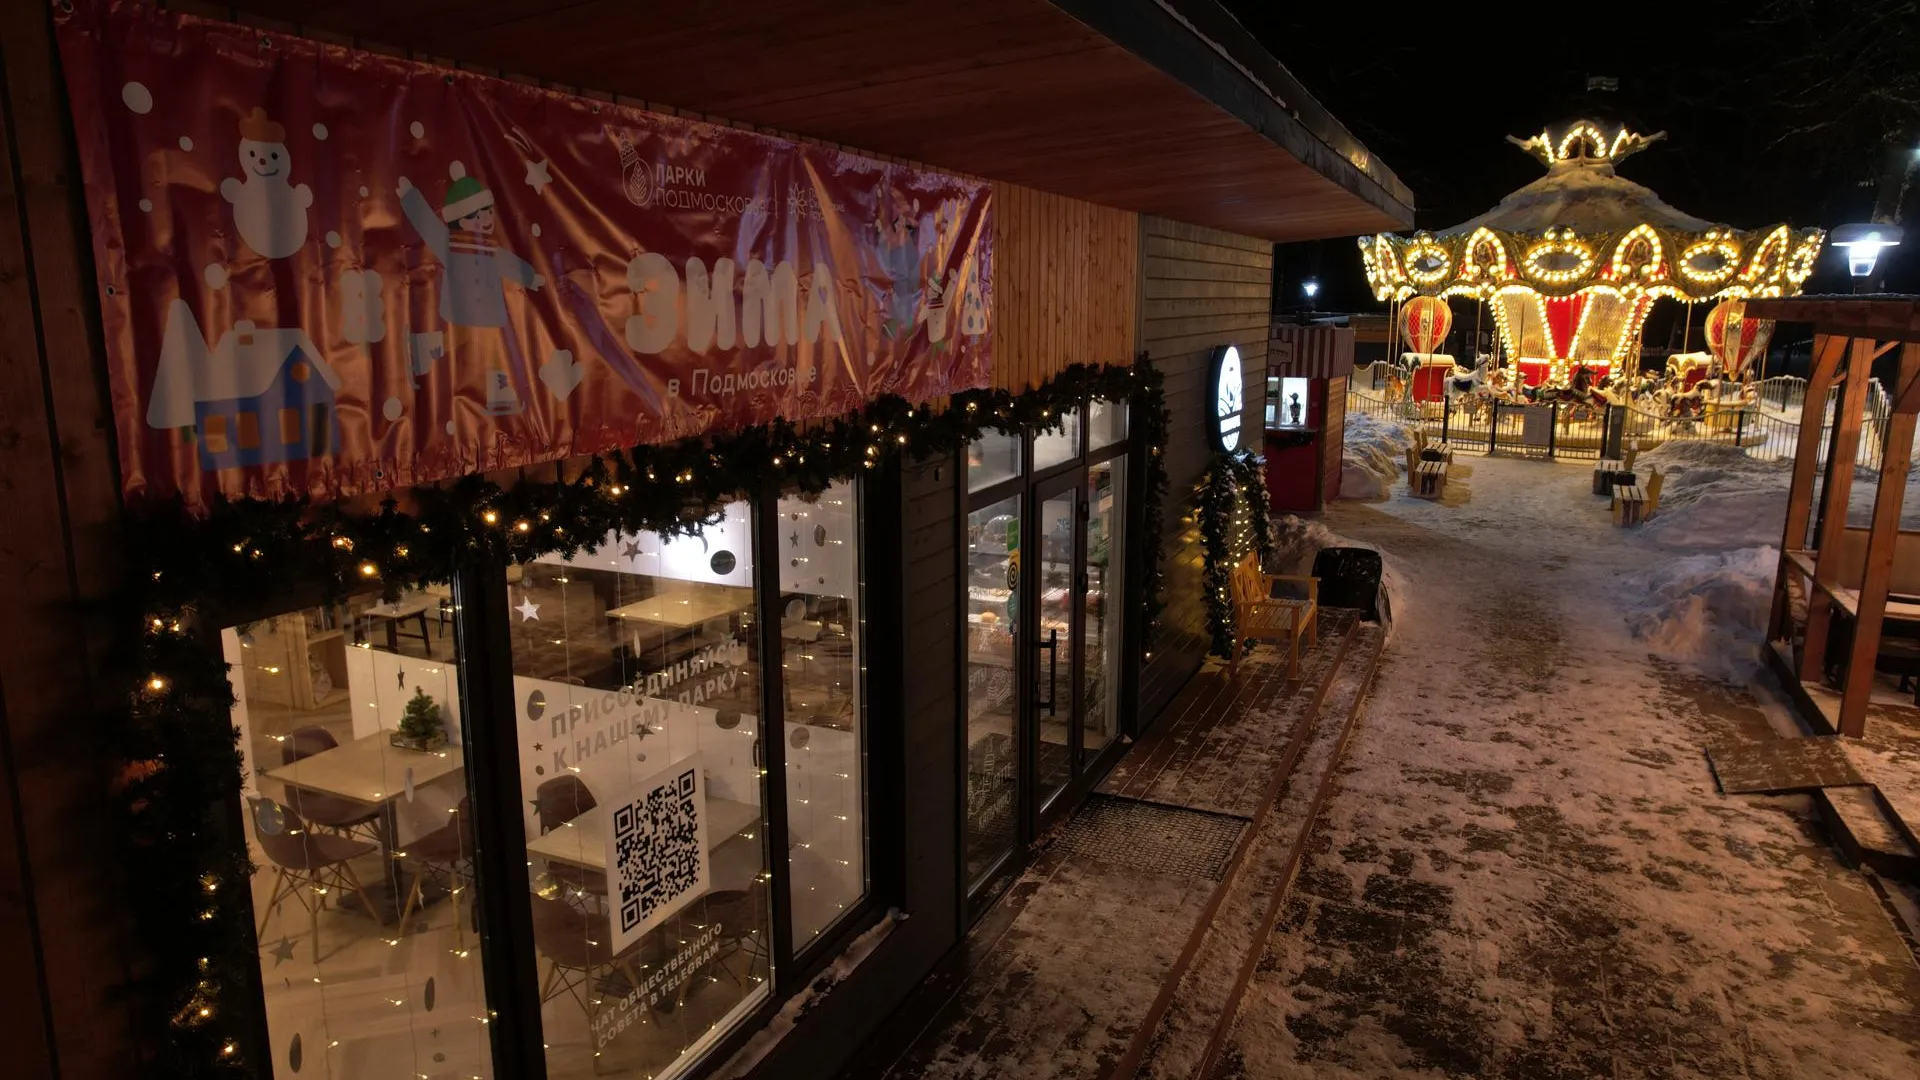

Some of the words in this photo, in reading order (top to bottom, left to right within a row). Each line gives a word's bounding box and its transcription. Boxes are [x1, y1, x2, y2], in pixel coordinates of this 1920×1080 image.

[656, 163, 706, 187] ПАРКИ
[625, 252, 843, 355] ЗИМА
[692, 365, 817, 397] Подмоскове
[551, 638, 740, 739] ПРИСОЕДИНЯЙСЯ
[553, 746, 568, 773] К
[576, 699, 671, 763] НАШЕМУ
[678, 667, 739, 713] ПАРКУ
[591, 1006, 616, 1033] ЧАТ
[619, 922, 722, 1012] ОБЩЕСТВЕННОГО
[598, 1003, 648, 1049] СОВЕТА
[650, 992, 659, 1006] В
[660, 942, 720, 998] TELEGRAM
